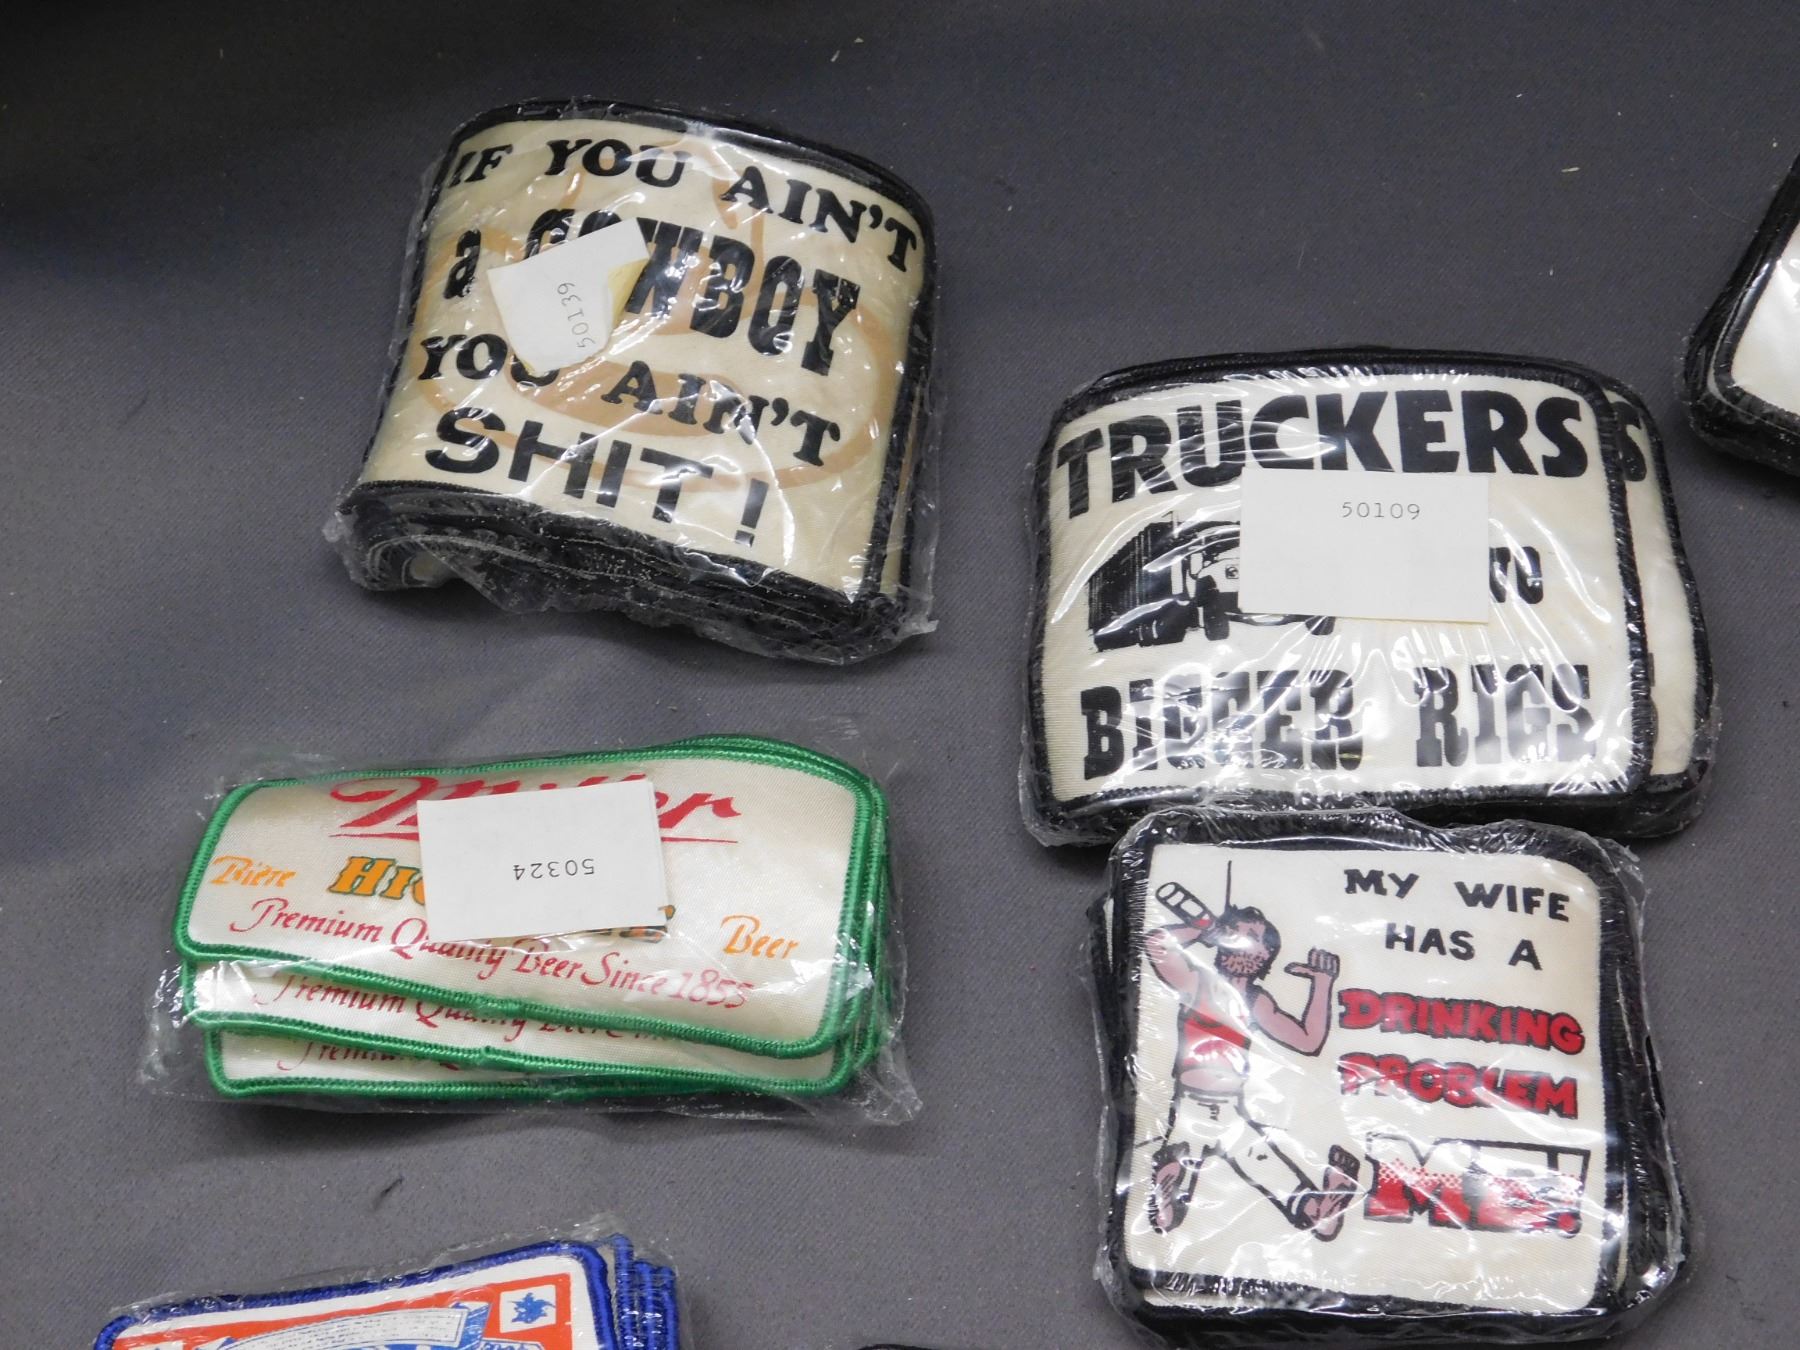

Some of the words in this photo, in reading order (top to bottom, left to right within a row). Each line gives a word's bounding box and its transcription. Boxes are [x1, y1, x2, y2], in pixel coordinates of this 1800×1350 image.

[448, 143, 513, 188] IF
[545, 138, 691, 188] YOU
[721, 165, 918, 273] AIN'T
[524, 207, 860, 376] WBOY
[556, 282, 597, 349] 50139
[602, 360, 841, 467] AIN'T
[1057, 389, 1589, 519] TRUCKERS
[1341, 500, 1421, 521] 50109
[1080, 669, 1364, 781] BIGGER
[1415, 663, 1597, 768] RIGS
[513, 857, 596, 881] 50324
[1344, 868, 1421, 899] MY
[1455, 880, 1571, 923] WIFE
[229, 897, 384, 943] Premium
[580, 951, 668, 997] Since
[669, 968, 754, 1009] 1855
[720, 914, 800, 961] Beer
[1385, 922, 1475, 961] HAS
[1509, 939, 1543, 970] A
[1338, 987, 1586, 1056] DRINKING
[1337, 1051, 1578, 1120] PROBLEM
[1363, 1132, 1592, 1239] ME!
